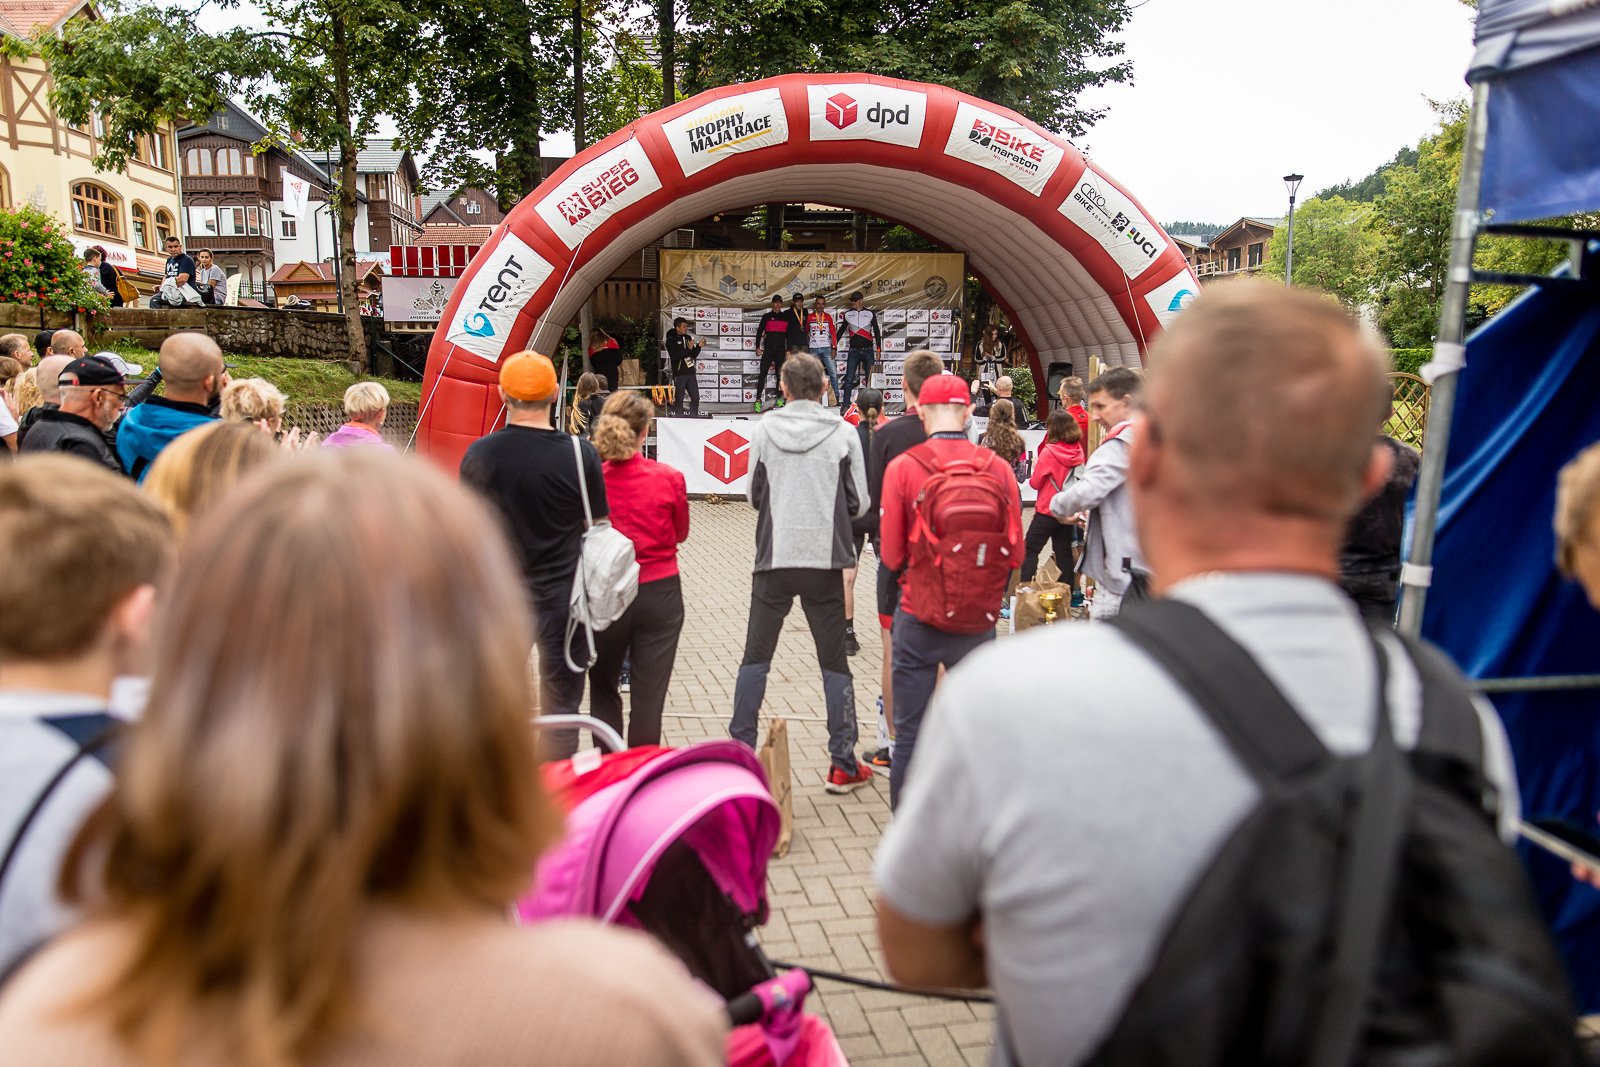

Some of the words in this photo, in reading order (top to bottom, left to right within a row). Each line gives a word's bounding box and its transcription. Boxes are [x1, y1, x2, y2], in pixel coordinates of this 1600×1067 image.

[686, 111, 744, 142] TROPHY
[866, 101, 910, 129] dpd
[690, 129, 733, 154] MAJA
[734, 114, 772, 139] RACE
[994, 128, 1045, 163] BIKE
[989, 144, 1039, 172] maraton
[581, 158, 630, 195] SUPER
[586, 167, 640, 210] BIEG
[1073, 192, 1094, 213] BIKE
[1132, 231, 1158, 259] UCI
[771, 260, 812, 268] KARPACZ
[816, 260, 839, 268] 2022
[809, 273, 841, 281] UPHILL
[742, 279, 767, 292] dpd
[809, 281, 843, 292] RACE
[877, 279, 907, 287] DOLNY
